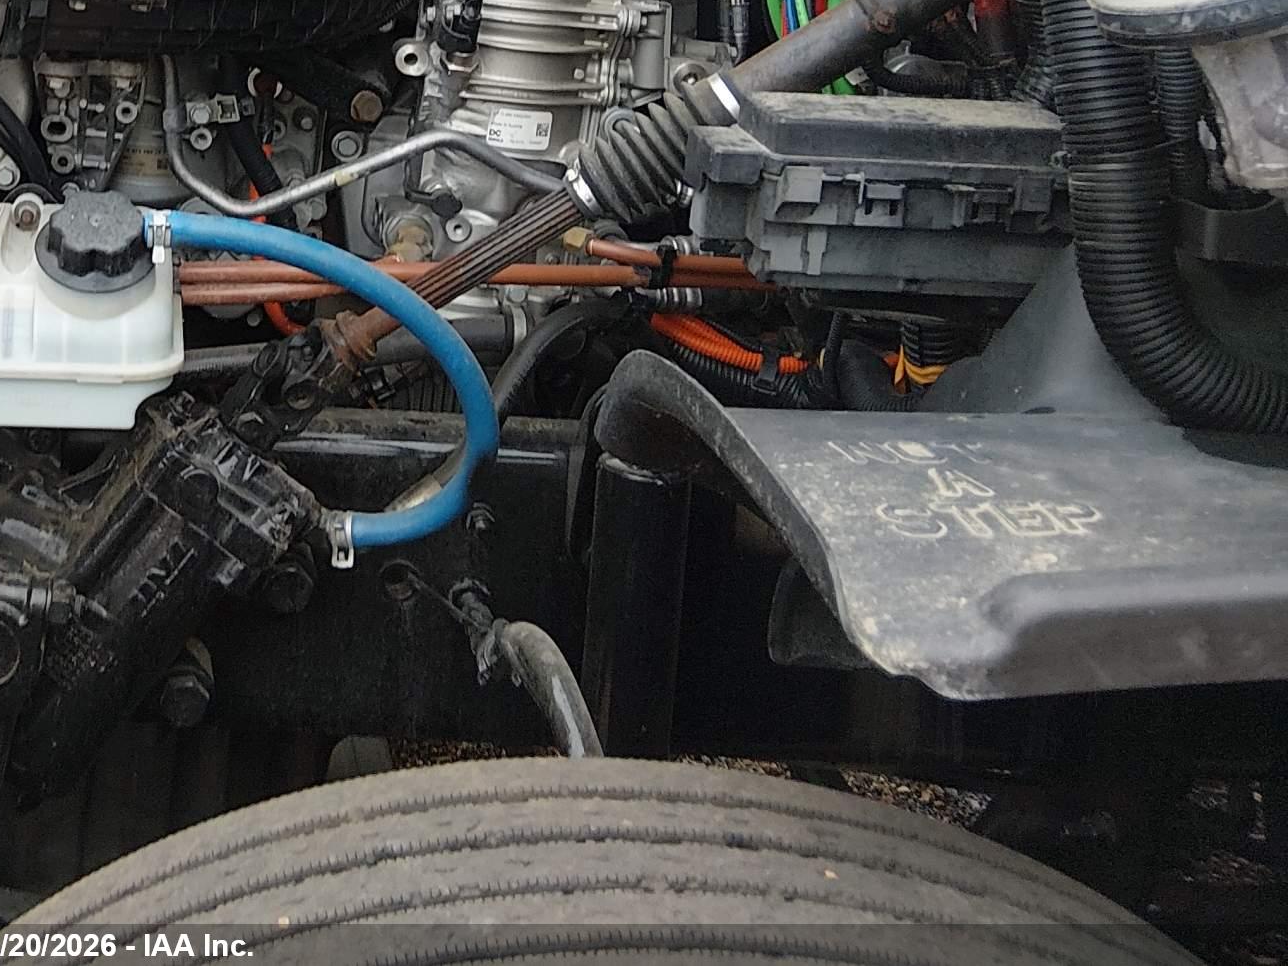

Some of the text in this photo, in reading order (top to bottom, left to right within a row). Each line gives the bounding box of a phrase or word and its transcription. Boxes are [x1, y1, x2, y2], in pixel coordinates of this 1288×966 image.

[827, 440, 994, 465] NOT
[926, 467, 997, 499] A
[876, 500, 1103, 540] STEP
